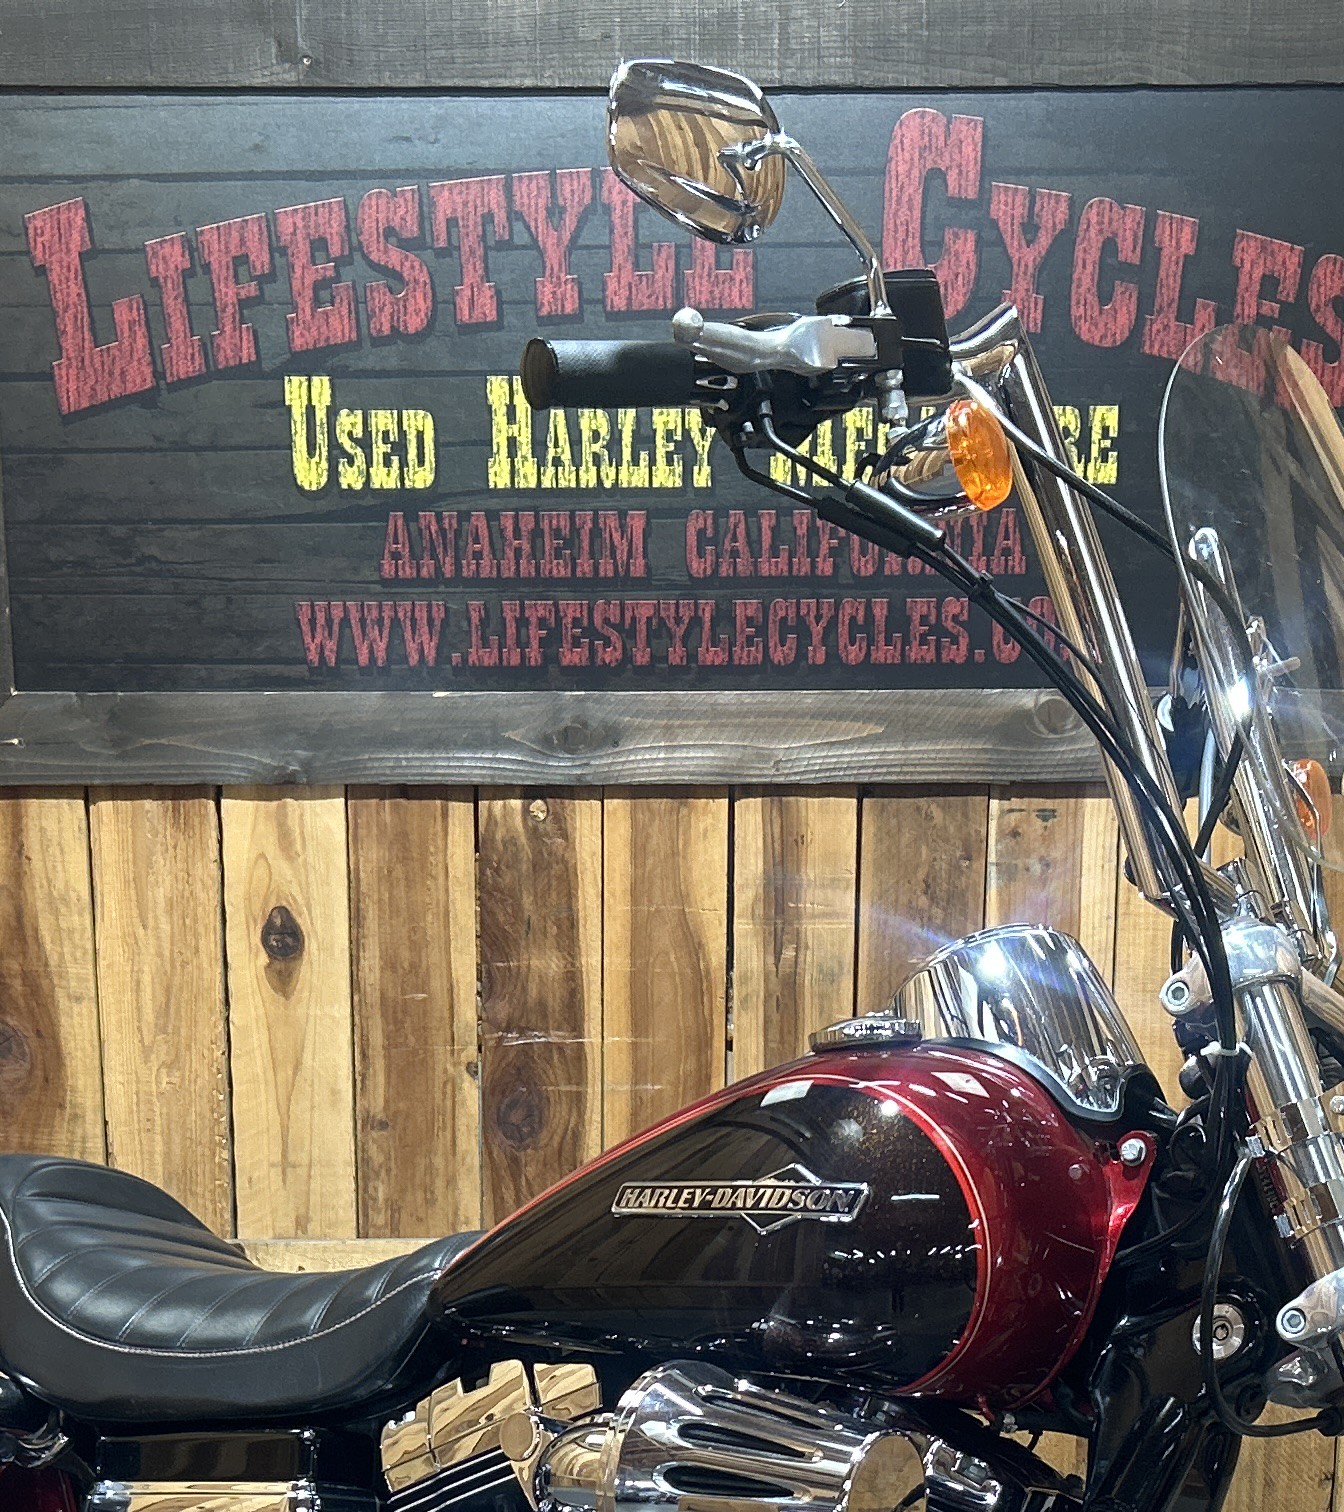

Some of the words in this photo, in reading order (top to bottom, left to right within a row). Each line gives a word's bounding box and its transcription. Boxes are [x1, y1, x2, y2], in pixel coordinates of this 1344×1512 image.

[284, 375, 437, 491] USED
[486, 375, 717, 489] HARLEY
[379, 510, 648, 579] ANAHEIM
[296, 596, 1102, 668] WWW.LIFESTYLECYCLES.CO
[619, 1186, 853, 1213] HARLEY-DAVIDSON
